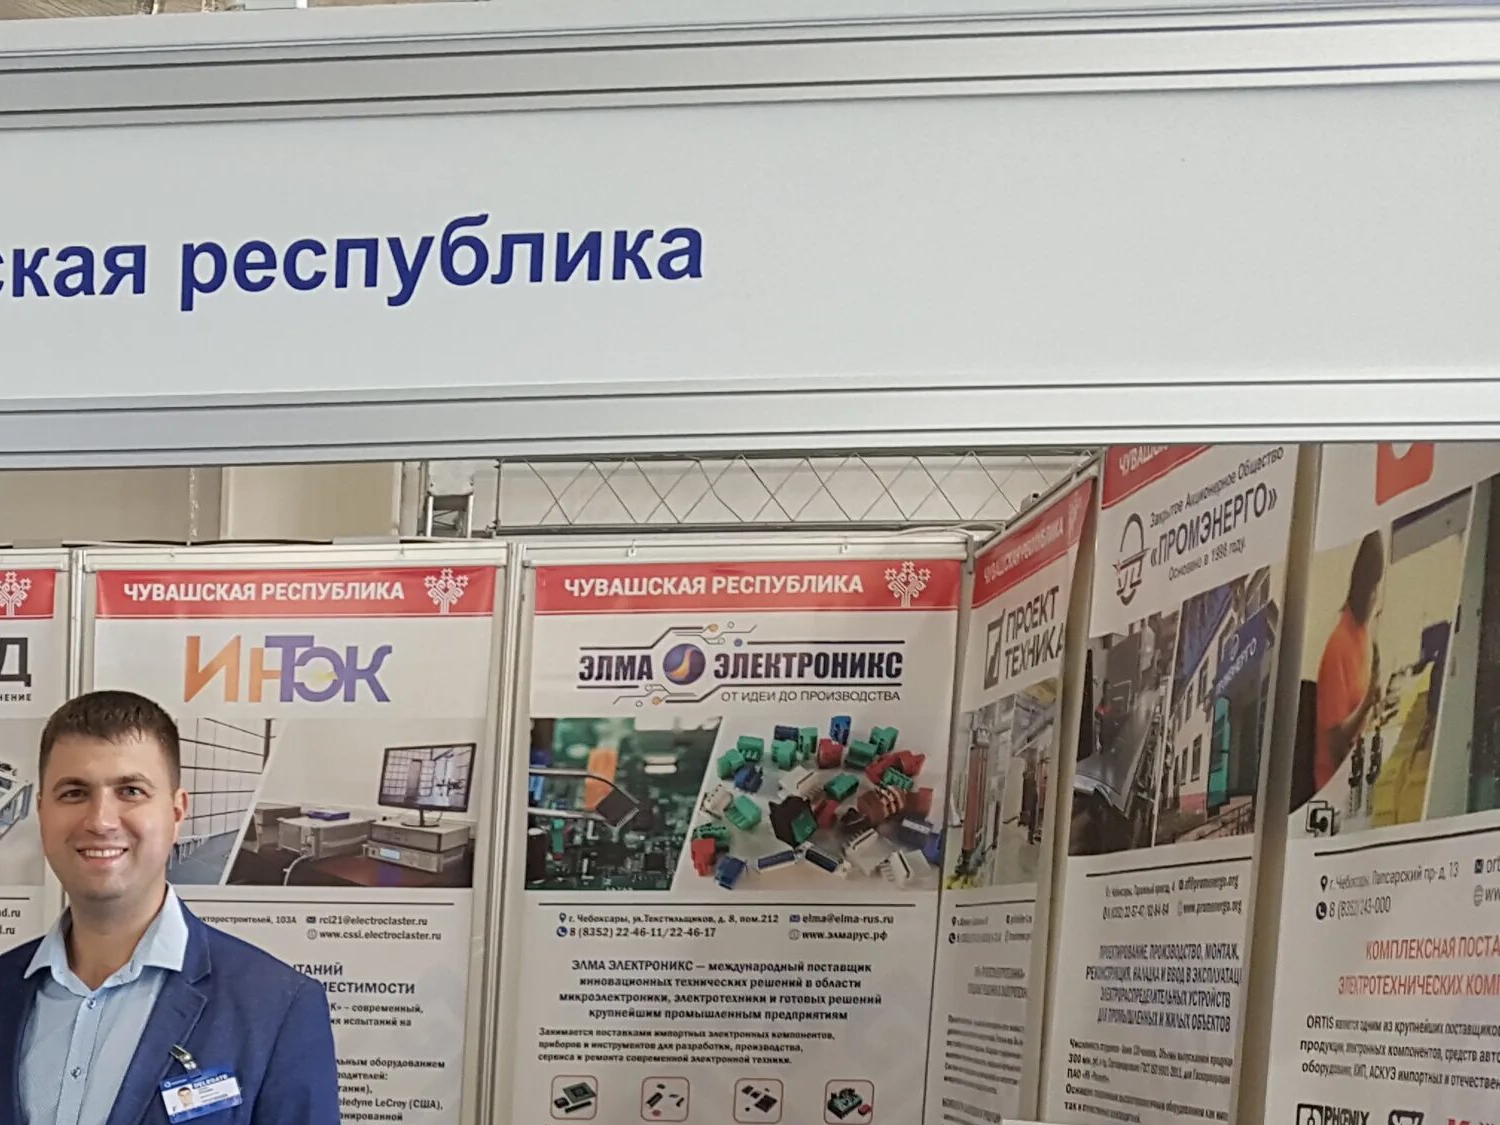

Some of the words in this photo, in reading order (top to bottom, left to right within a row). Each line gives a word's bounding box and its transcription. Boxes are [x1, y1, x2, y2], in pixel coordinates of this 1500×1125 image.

[178, 213, 703, 312] республика
[1238, 447, 1284, 479] Общество
[1151, 482, 1278, 567] «ПРОМЭНЕРГО»
[124, 582, 256, 602] ЧУВАШСКАЯ
[261, 581, 405, 601] РЕСПУБЛИКА
[564, 576, 706, 597] ЧУВАШСКАЯ
[712, 574, 864, 594] РЕСПУБЛИКА
[1005, 585, 1060, 643] ПРОЕКТ
[1004, 622, 1064, 680] ТЕХНИКА
[578, 655, 653, 682] ЭЛМА
[714, 652, 903, 680] ЭЛЕКТРОНИКС
[721, 692, 739, 702] ОТ
[778, 692, 798, 703] ДО
[800, 691, 901, 702] ПРОИЗВОДСТВА
[577, 915, 631, 924] Чебоксары,
[802, 914, 894, 924] elma@elma-rus.ru
[569, 927, 576, 937] 8
[578, 927, 614, 938] (8352)
[802, 930, 888, 941] www.элмарус.рф
[1366, 936, 1455, 960] КОМПЛЕКСНАЯ
[295, 962, 343, 976] ТАНИЙ
[572, 960, 606, 971] ЭЛМА
[609, 960, 693, 971] ЭЛЕКТРОНИКС
[708, 962, 804, 974] международный
[807, 964, 872, 973] поставщик
[580, 978, 672, 988] инновационных
[675, 978, 747, 988] технических
[750, 978, 802, 989] решений
[815, 978, 861, 988] области
[1338, 973, 1462, 996] ЭЛЕКТРОТЕХНИЧЕСКИХ
[559, 993, 671, 1003] микроэлектроники,
[674, 994, 766, 1005] электротехники
[779, 996, 826, 1004] готовых
[828, 994, 882, 1005] решений
[352, 1004, 424, 1014] современный,
[589, 1008, 661, 1019] крупнейшим
[664, 1010, 761, 1020] промышленным
[765, 1011, 848, 1022] предприятиям
[344, 1018, 398, 1027] испытаний
[1192, 1015, 1231, 1032] ОБЪЕКТОВ
[1307, 1015, 1334, 1029] ORTIS
[369, 1059, 445, 1071] оборудованием
[375, 1099, 407, 1110] LeCroy
